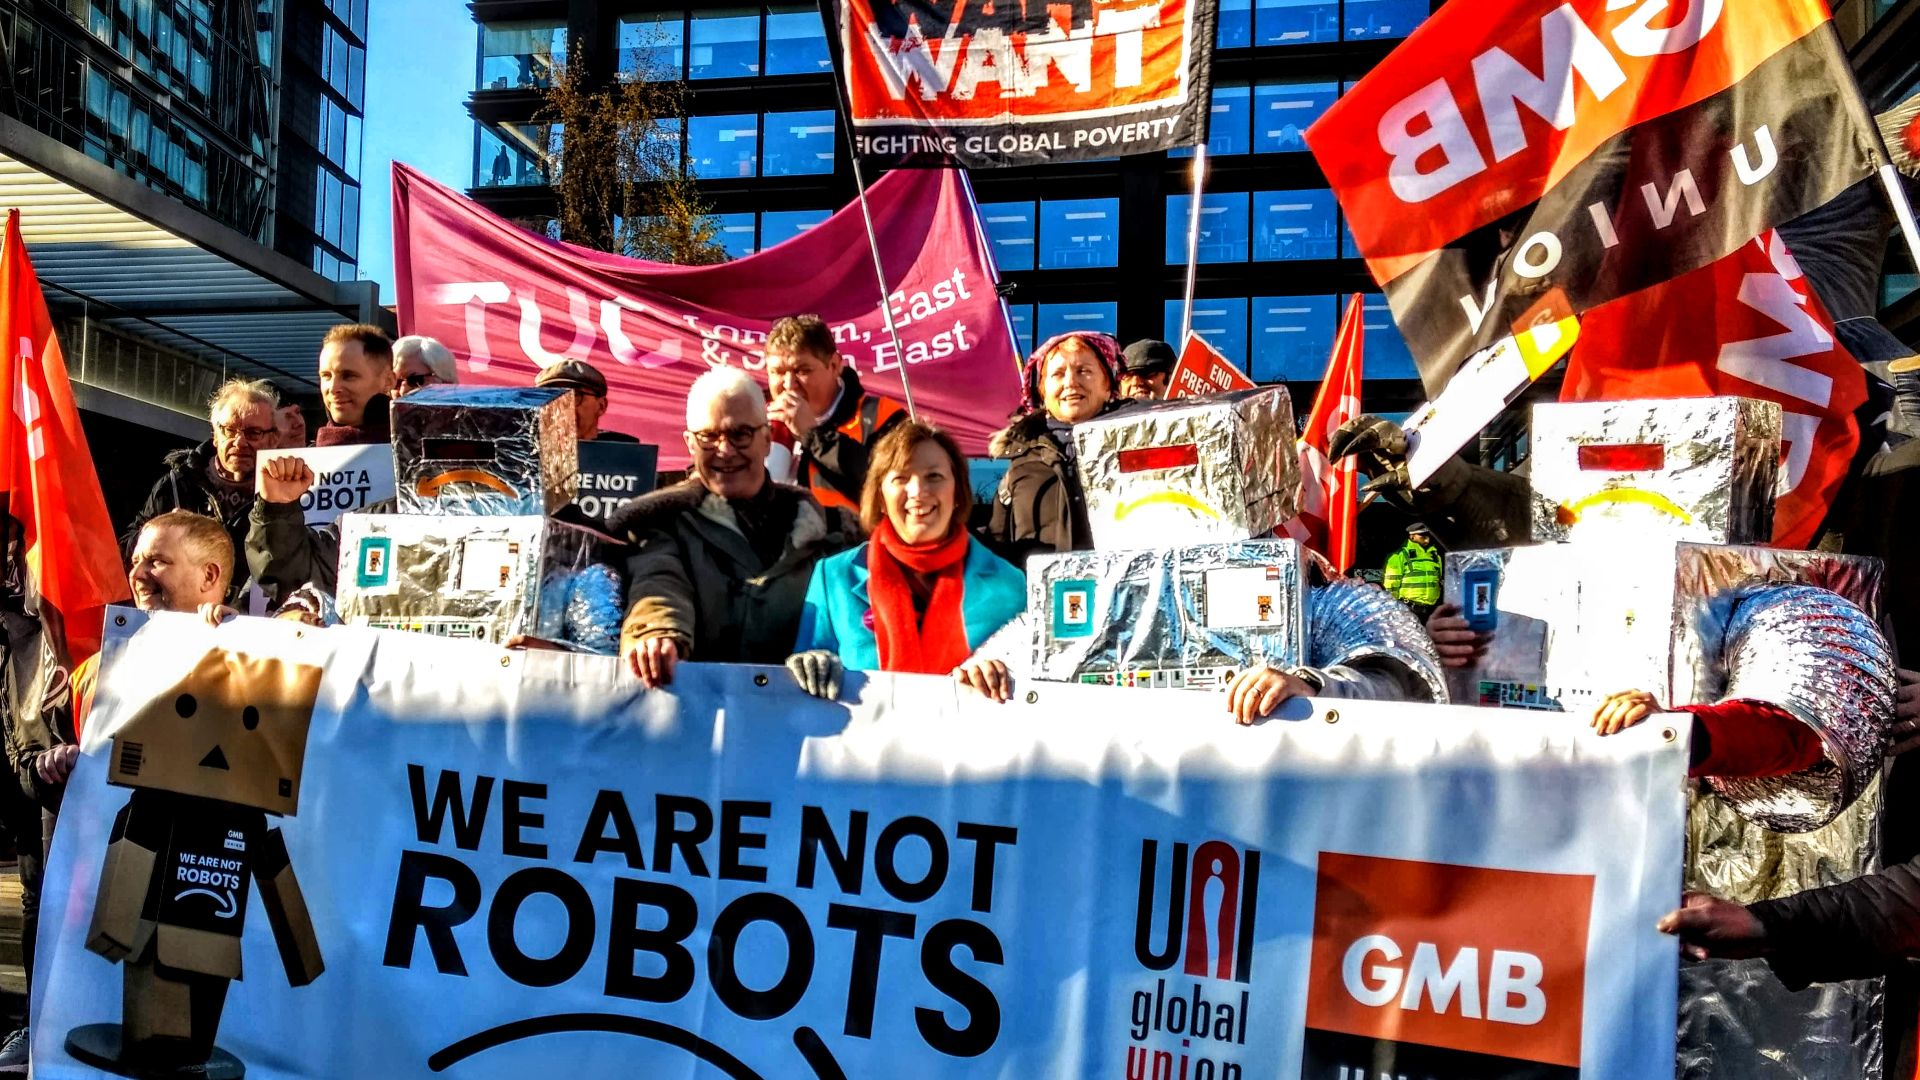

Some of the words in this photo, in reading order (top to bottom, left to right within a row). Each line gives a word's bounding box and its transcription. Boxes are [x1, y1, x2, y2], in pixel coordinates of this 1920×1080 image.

[865, 8, 1161, 101] WANT
[856, 134, 957, 155] FIGHTING
[973, 132, 1066, 154] GLOBAL
[1073, 114, 1181, 149] POVERTY
[432, 280, 682, 373] TUC
[683, 314, 872, 345] Lonn,
[877, 267, 972, 333] East
[872, 319, 971, 373] East
[1210, 364, 1232, 390] END
[299, 486, 371, 511] OBOT
[319, 471, 354, 486] NOT
[357, 469, 370, 484] A
[595, 474, 638, 492] NOT
[227, 830, 244, 839] GMB
[406, 763, 548, 860] WE
[573, 789, 772, 884] ARE
[796, 805, 1019, 913] NOT
[177, 866, 239, 889] ROBOTS
[180, 853, 196, 864] WE
[198, 856, 218, 867] ARE
[221, 859, 242, 871] NOT
[1135, 838, 1261, 985] UNI
[382, 849, 1005, 1058] ROBOTS
[1342, 934, 1547, 1026] GMB
[1130, 978, 1250, 1046] global
